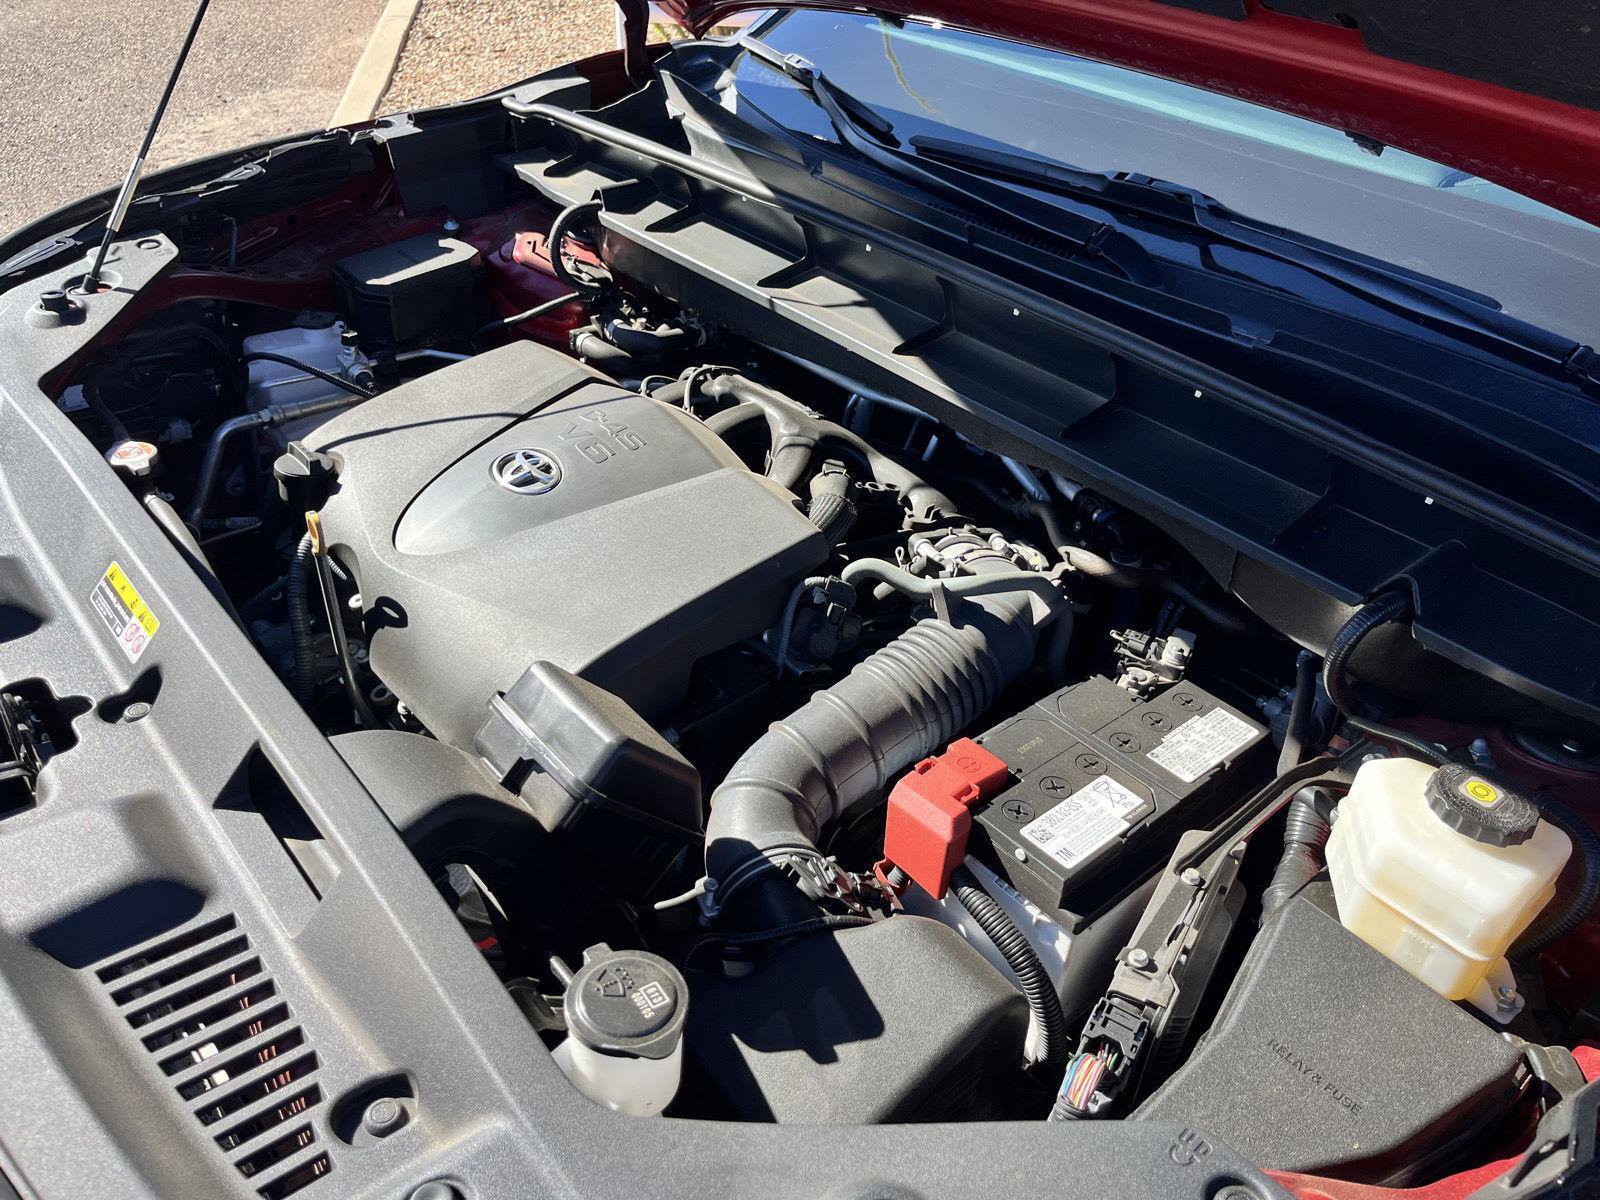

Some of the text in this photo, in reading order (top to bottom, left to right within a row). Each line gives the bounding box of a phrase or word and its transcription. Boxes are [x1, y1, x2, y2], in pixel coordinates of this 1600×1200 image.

[558, 422, 615, 464] V6
[1266, 1040, 1363, 1116] RELAY & FUSE
